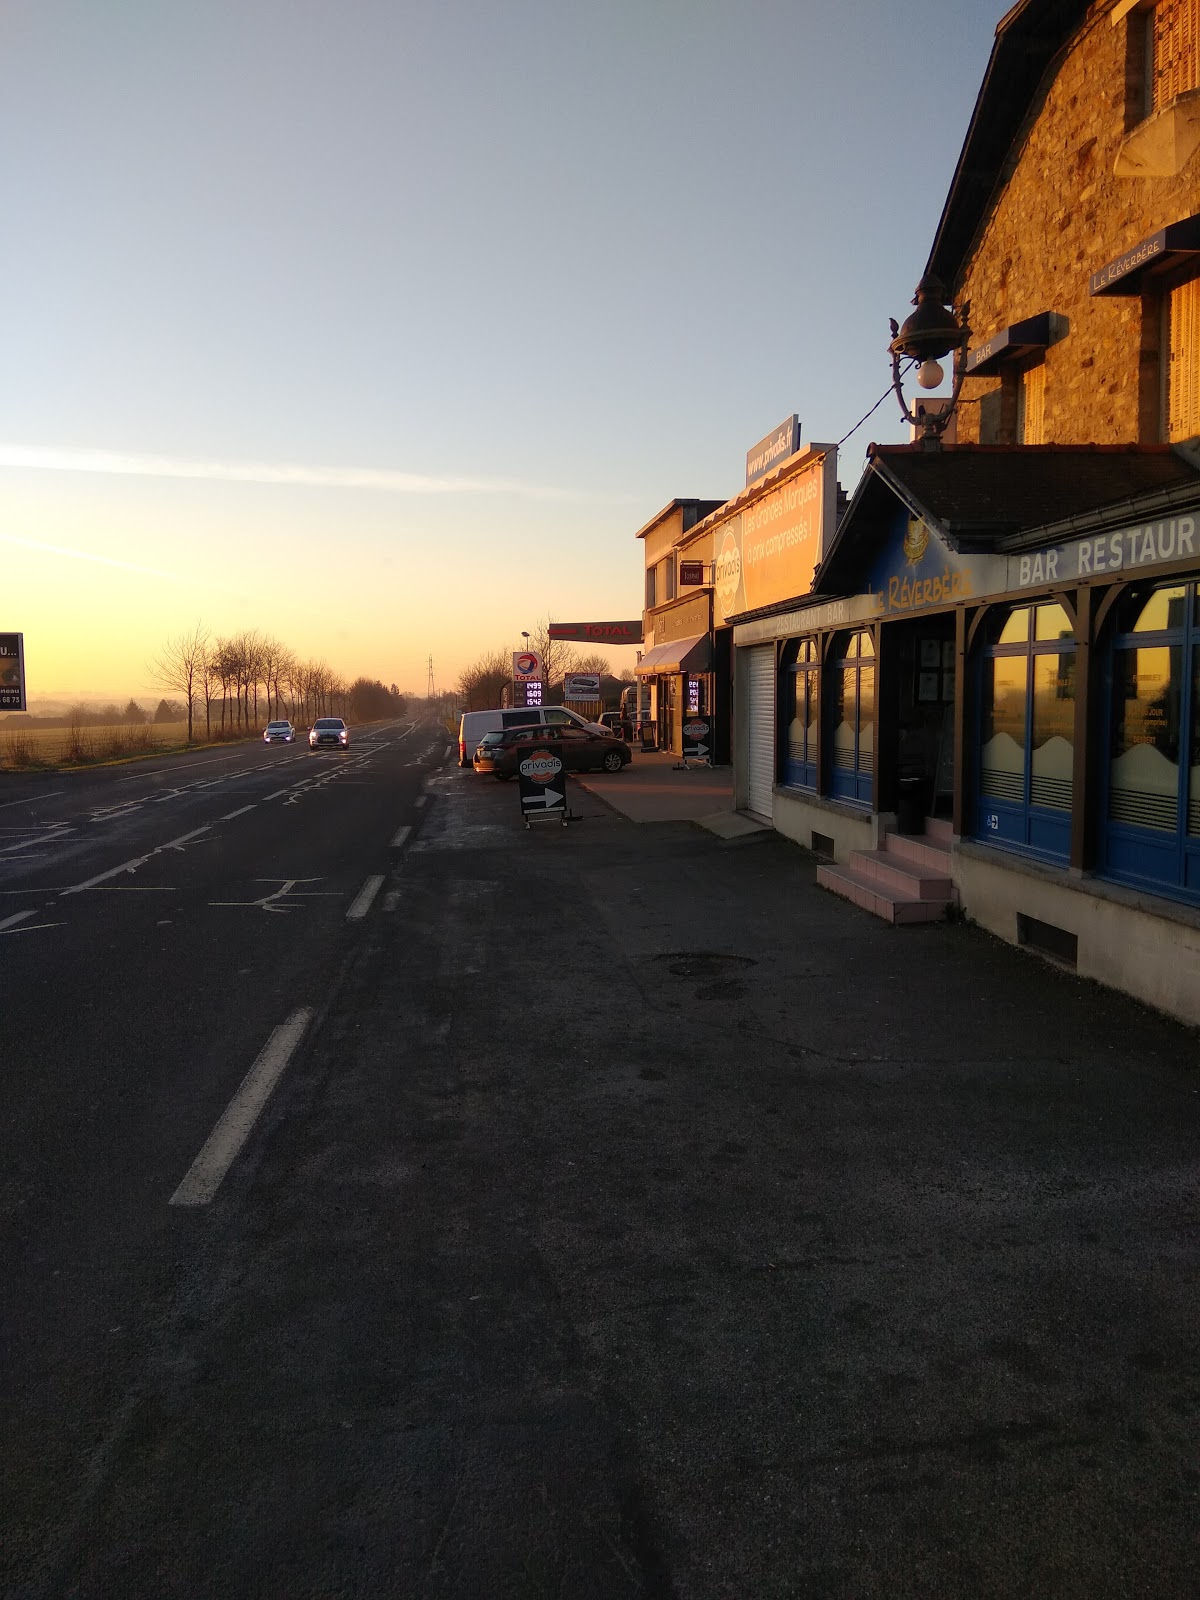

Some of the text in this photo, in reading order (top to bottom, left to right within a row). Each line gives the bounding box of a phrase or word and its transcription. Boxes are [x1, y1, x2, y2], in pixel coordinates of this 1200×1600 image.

[975, 343, 992, 363] BAR
[747, 426, 792, 476] www.privadis.fr
[744, 479, 818, 536] Les Grandes Marques
[747, 543, 752, 564] à
[752, 538, 765, 568] prix
[765, 516, 808, 558] compressés
[1019, 516, 1200, 586] BAR RESTAUR
[776, 601, 844, 634] RESTAURANT BAR
[0, 646, 17, 656] U...
[526, 690, 542, 698] 1609
[526, 698, 542, 706] 1542
[521, 758, 561, 772] privadis
